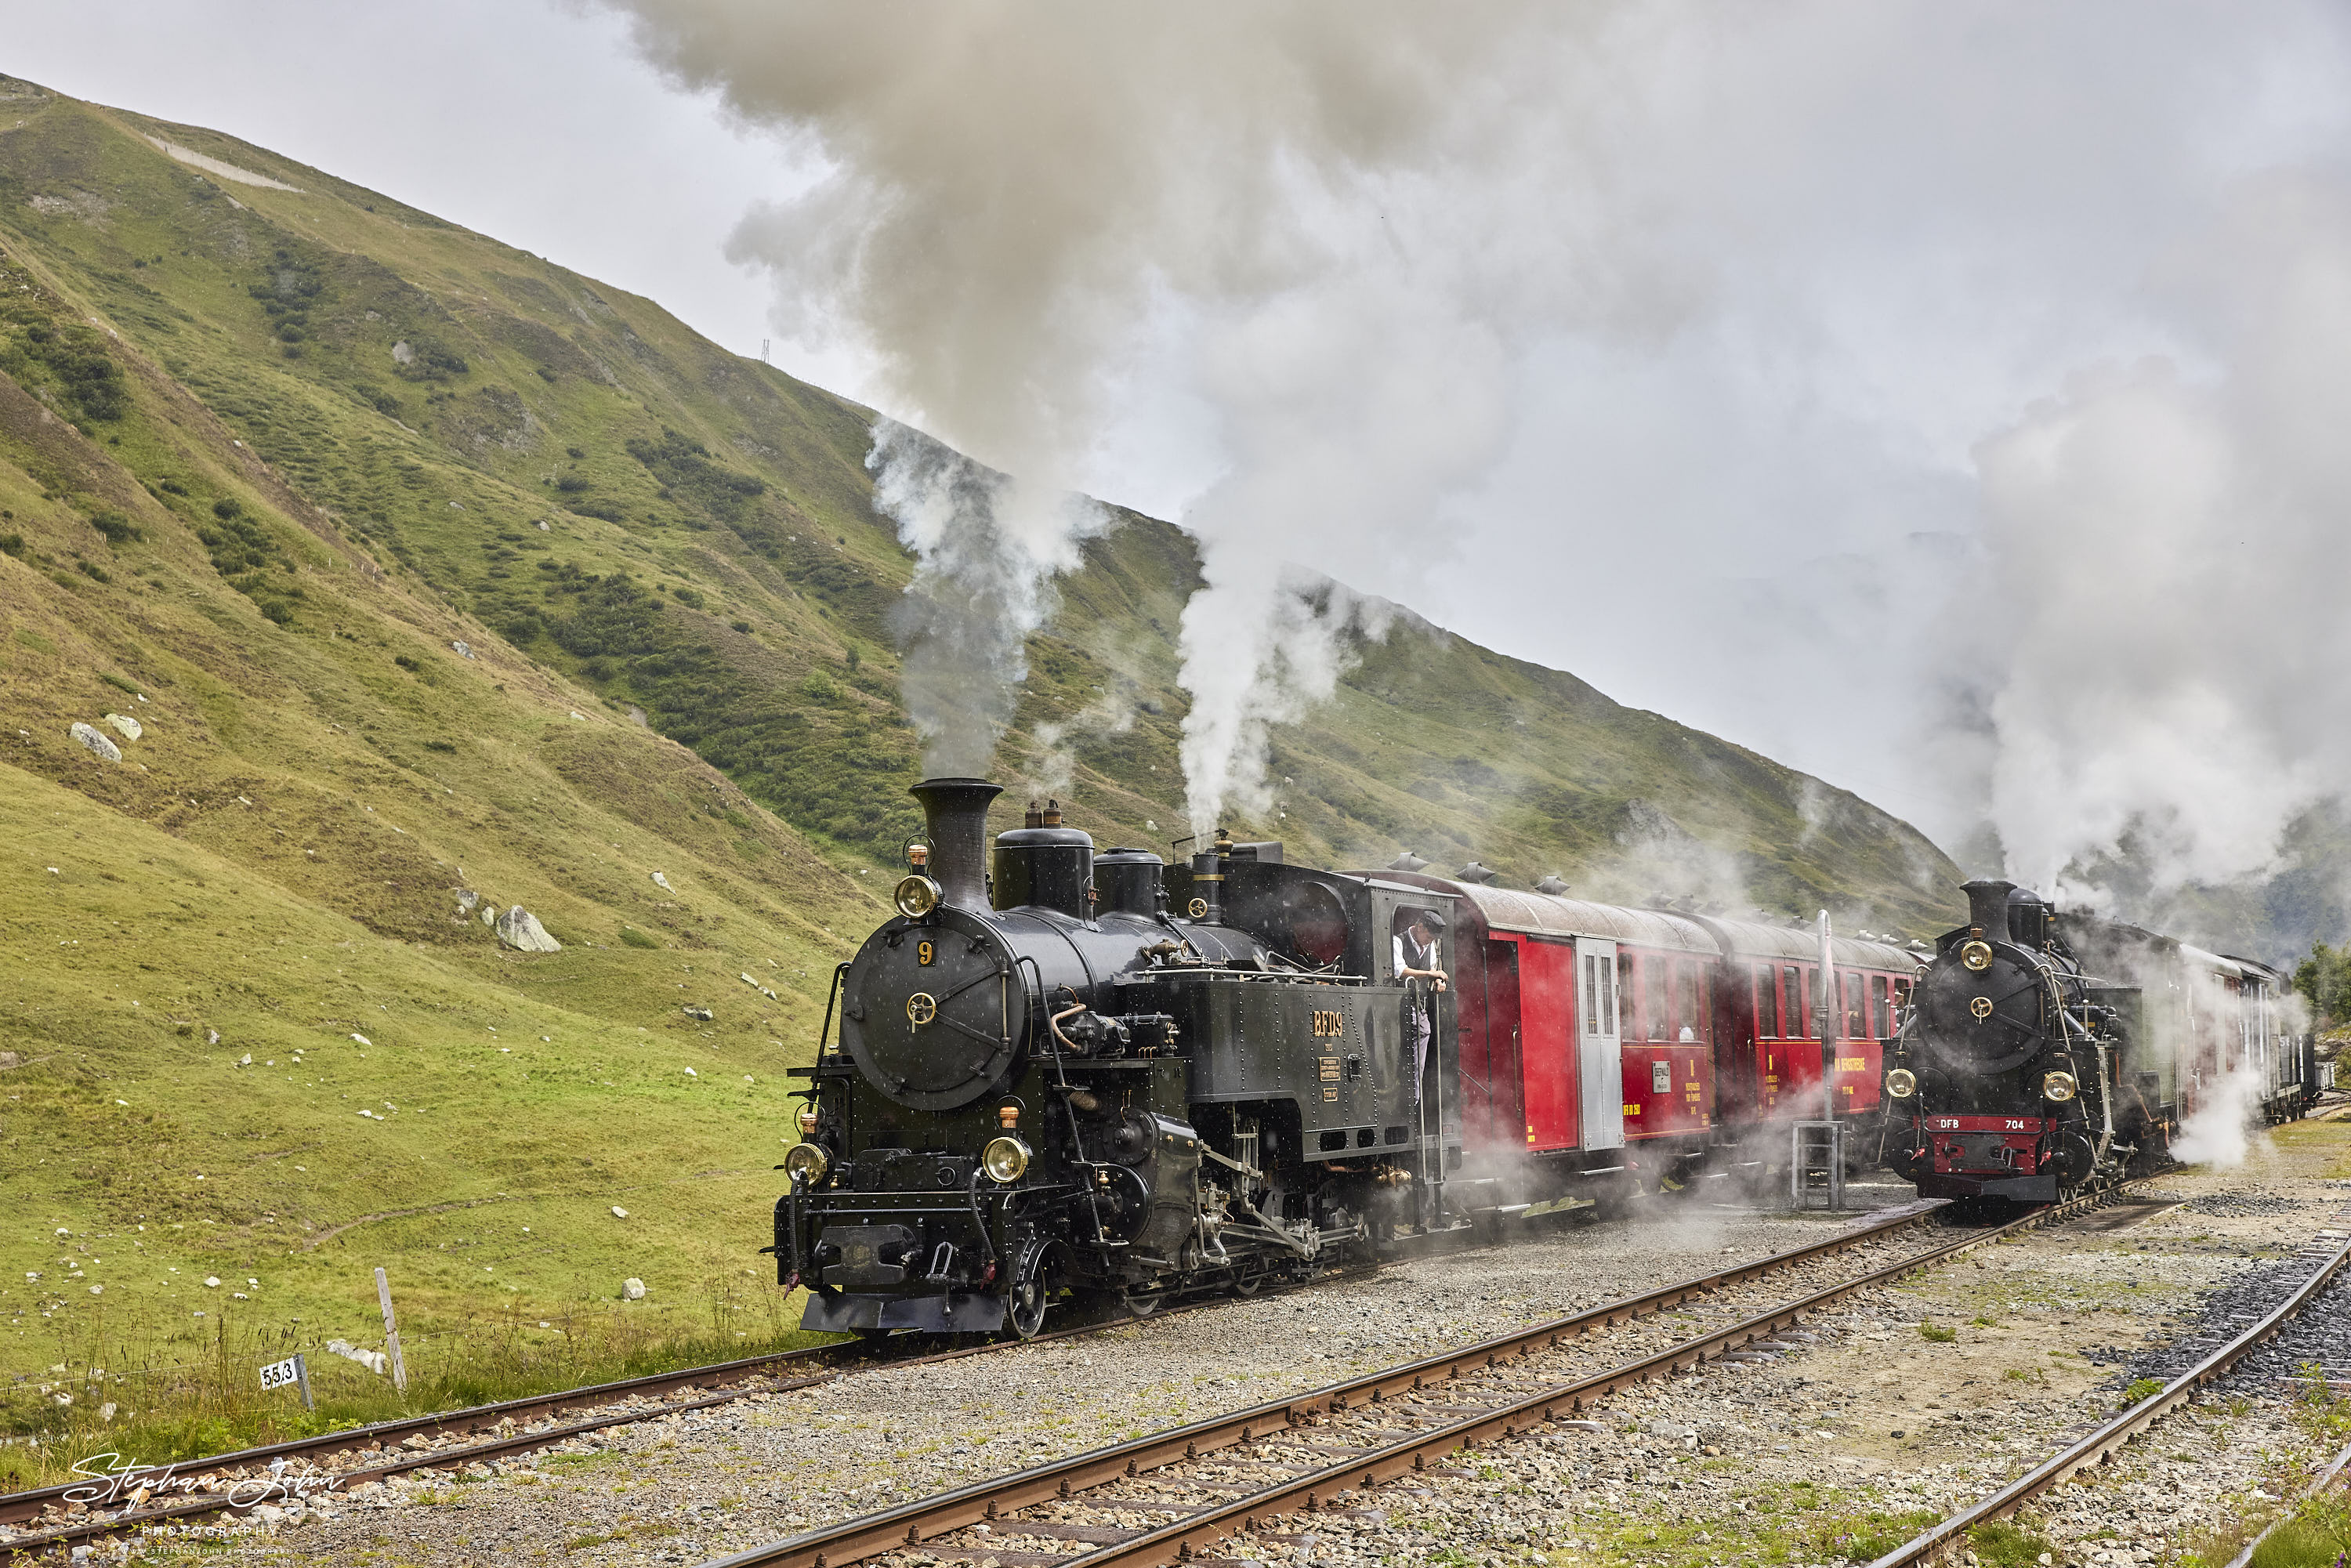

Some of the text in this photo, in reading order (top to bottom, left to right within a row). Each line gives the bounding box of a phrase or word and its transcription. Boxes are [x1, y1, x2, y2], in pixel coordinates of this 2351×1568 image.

[918, 942, 933, 965] 9
[1940, 1119, 2023, 1129] DFB 704
[262, 1363, 292, 1385] 55.3
